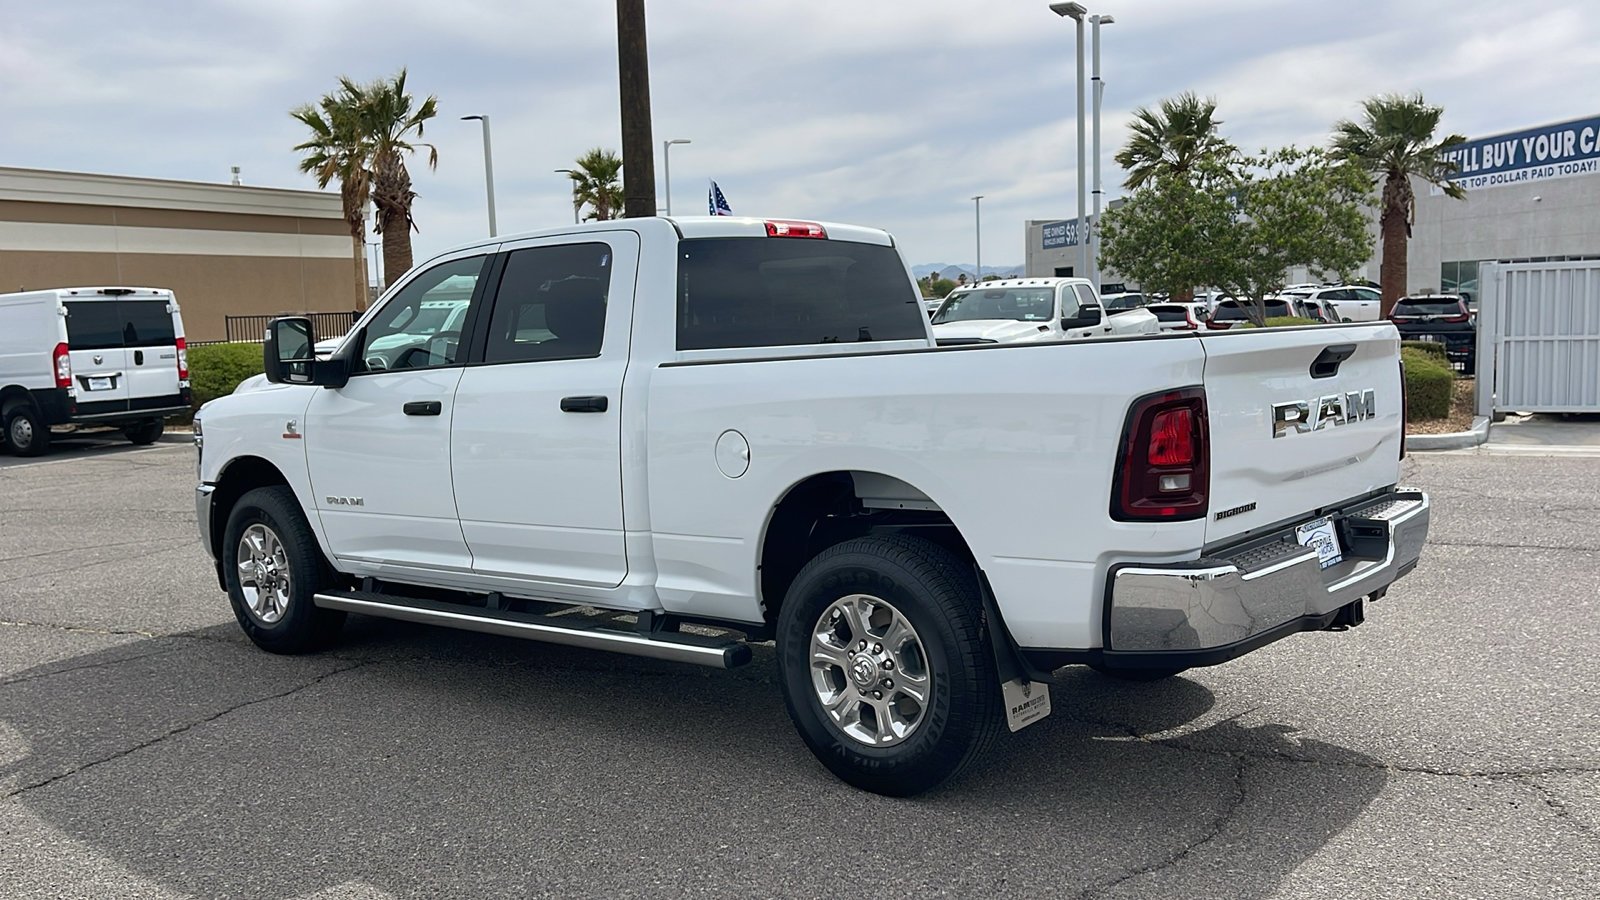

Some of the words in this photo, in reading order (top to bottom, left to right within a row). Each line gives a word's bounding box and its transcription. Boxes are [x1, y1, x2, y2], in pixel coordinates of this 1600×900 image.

[1434, 147, 1479, 177] E'LL
[1482, 139, 1518, 170] BUY
[1521, 129, 1576, 163] YOUR
[1451, 179, 1467, 190] OR
[1470, 176, 1487, 188] TOP
[1490, 170, 1528, 185] DOLLAR
[1531, 166, 1555, 180] PAID
[1558, 160, 1597, 175] TODAY!
[1271, 388, 1376, 439] RAM
[326, 496, 364, 507] RAM
[1215, 501, 1257, 521] BIGHORN
[1011, 700, 1030, 715] RAM
